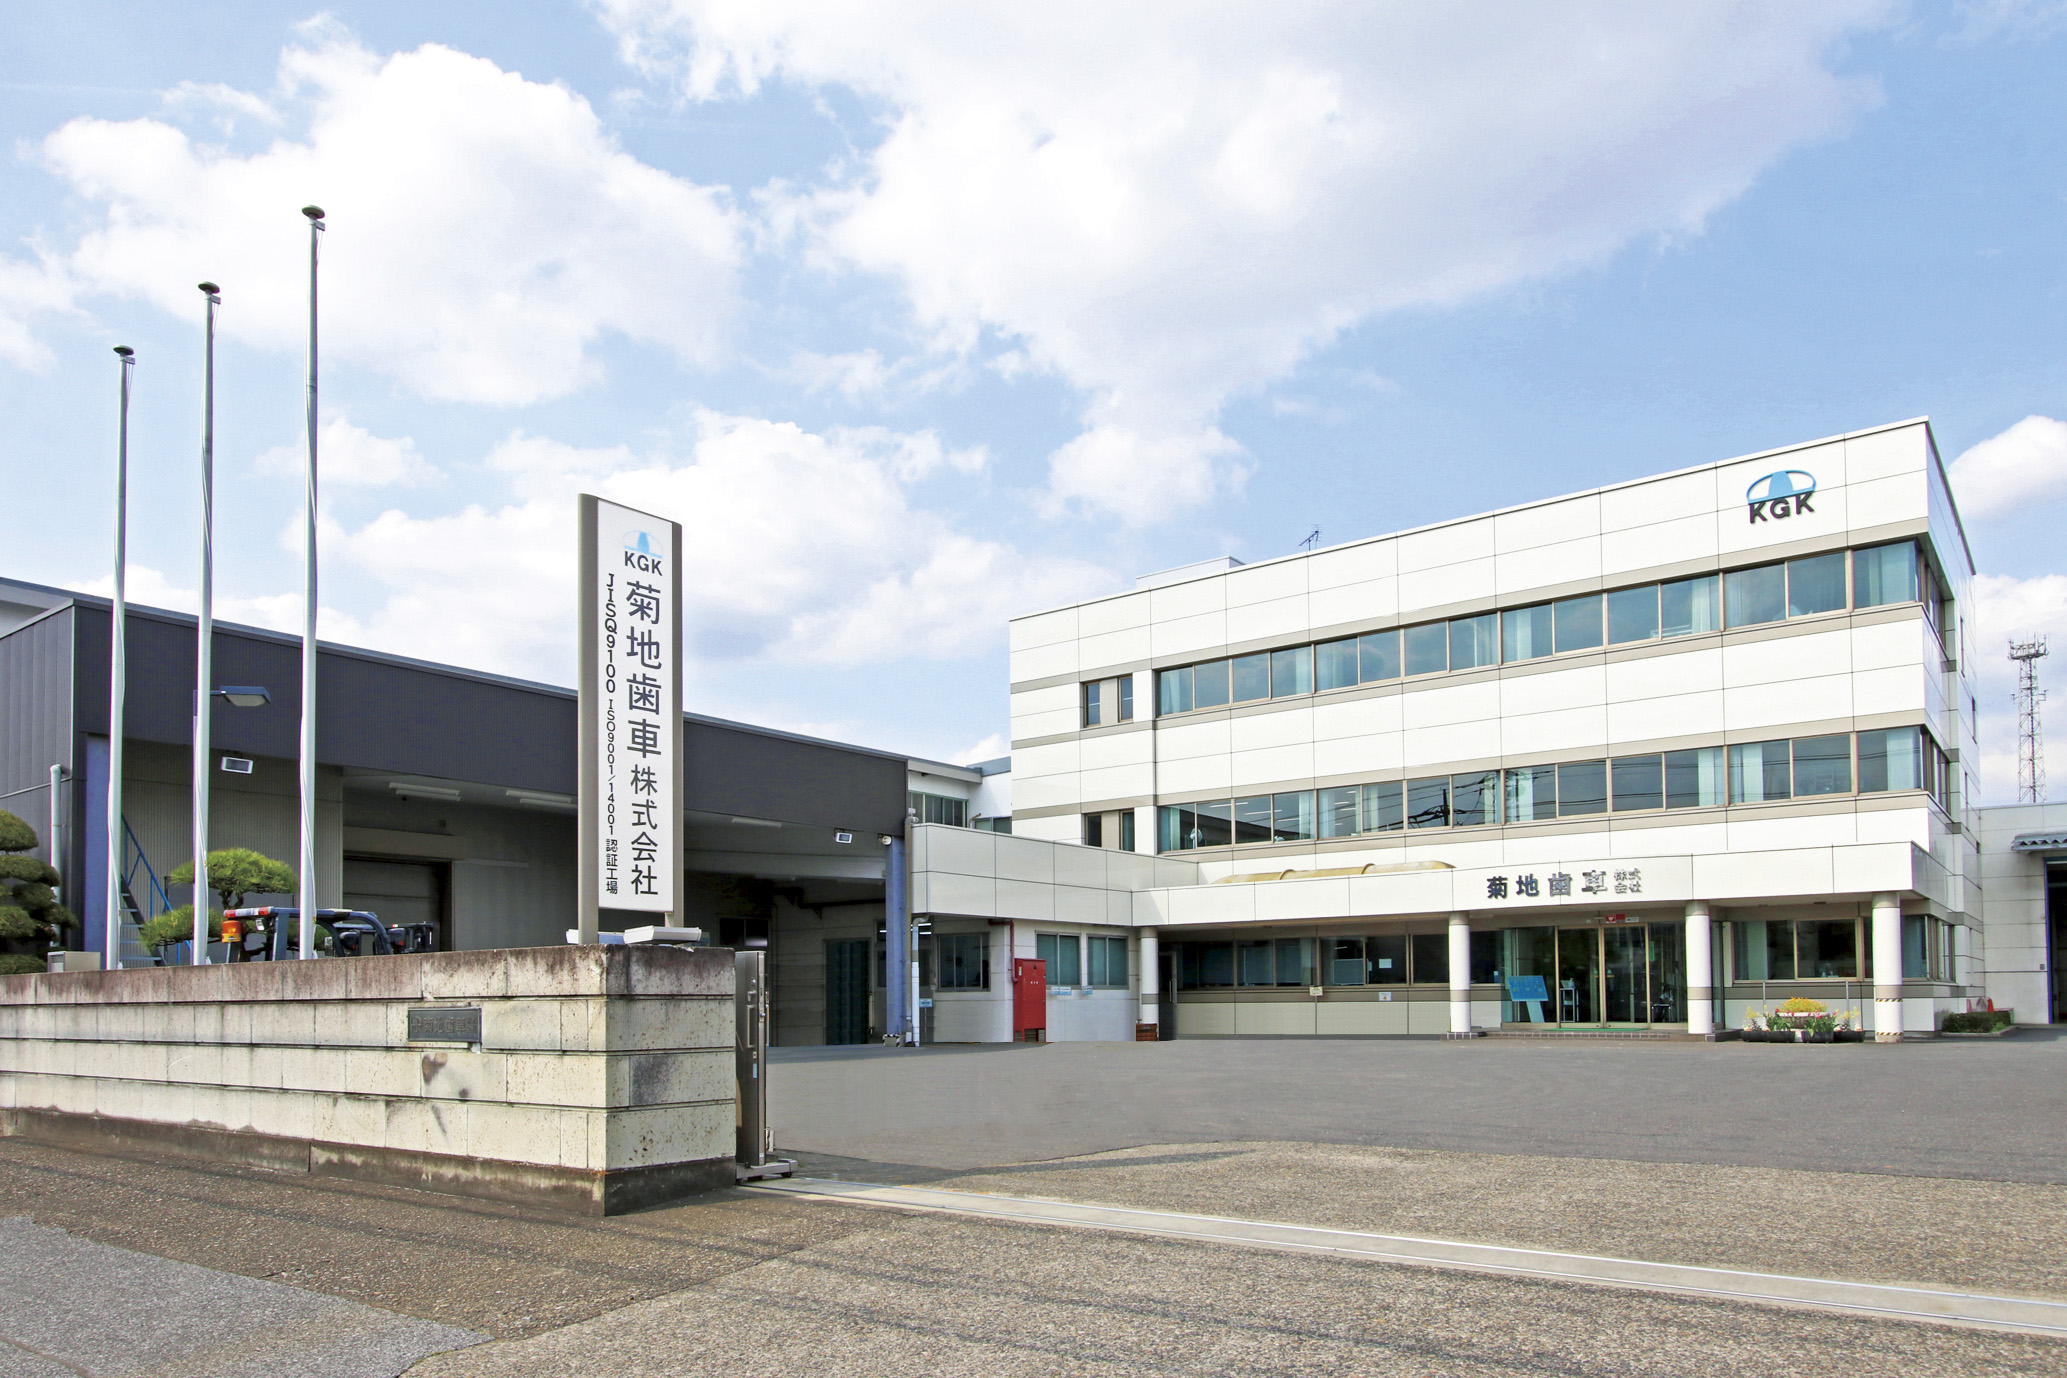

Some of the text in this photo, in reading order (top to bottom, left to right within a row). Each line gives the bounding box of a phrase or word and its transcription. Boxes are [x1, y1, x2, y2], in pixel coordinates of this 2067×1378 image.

[1749, 491, 1815, 524] KGK
[624, 551, 663, 576] KGK
[605, 573, 617, 694] JISQ9100
[625, 580, 662, 895] 菊地歯車株式会社
[606, 838, 618, 895] 認証工場
[1486, 870, 1608, 899] 菊地歯車
